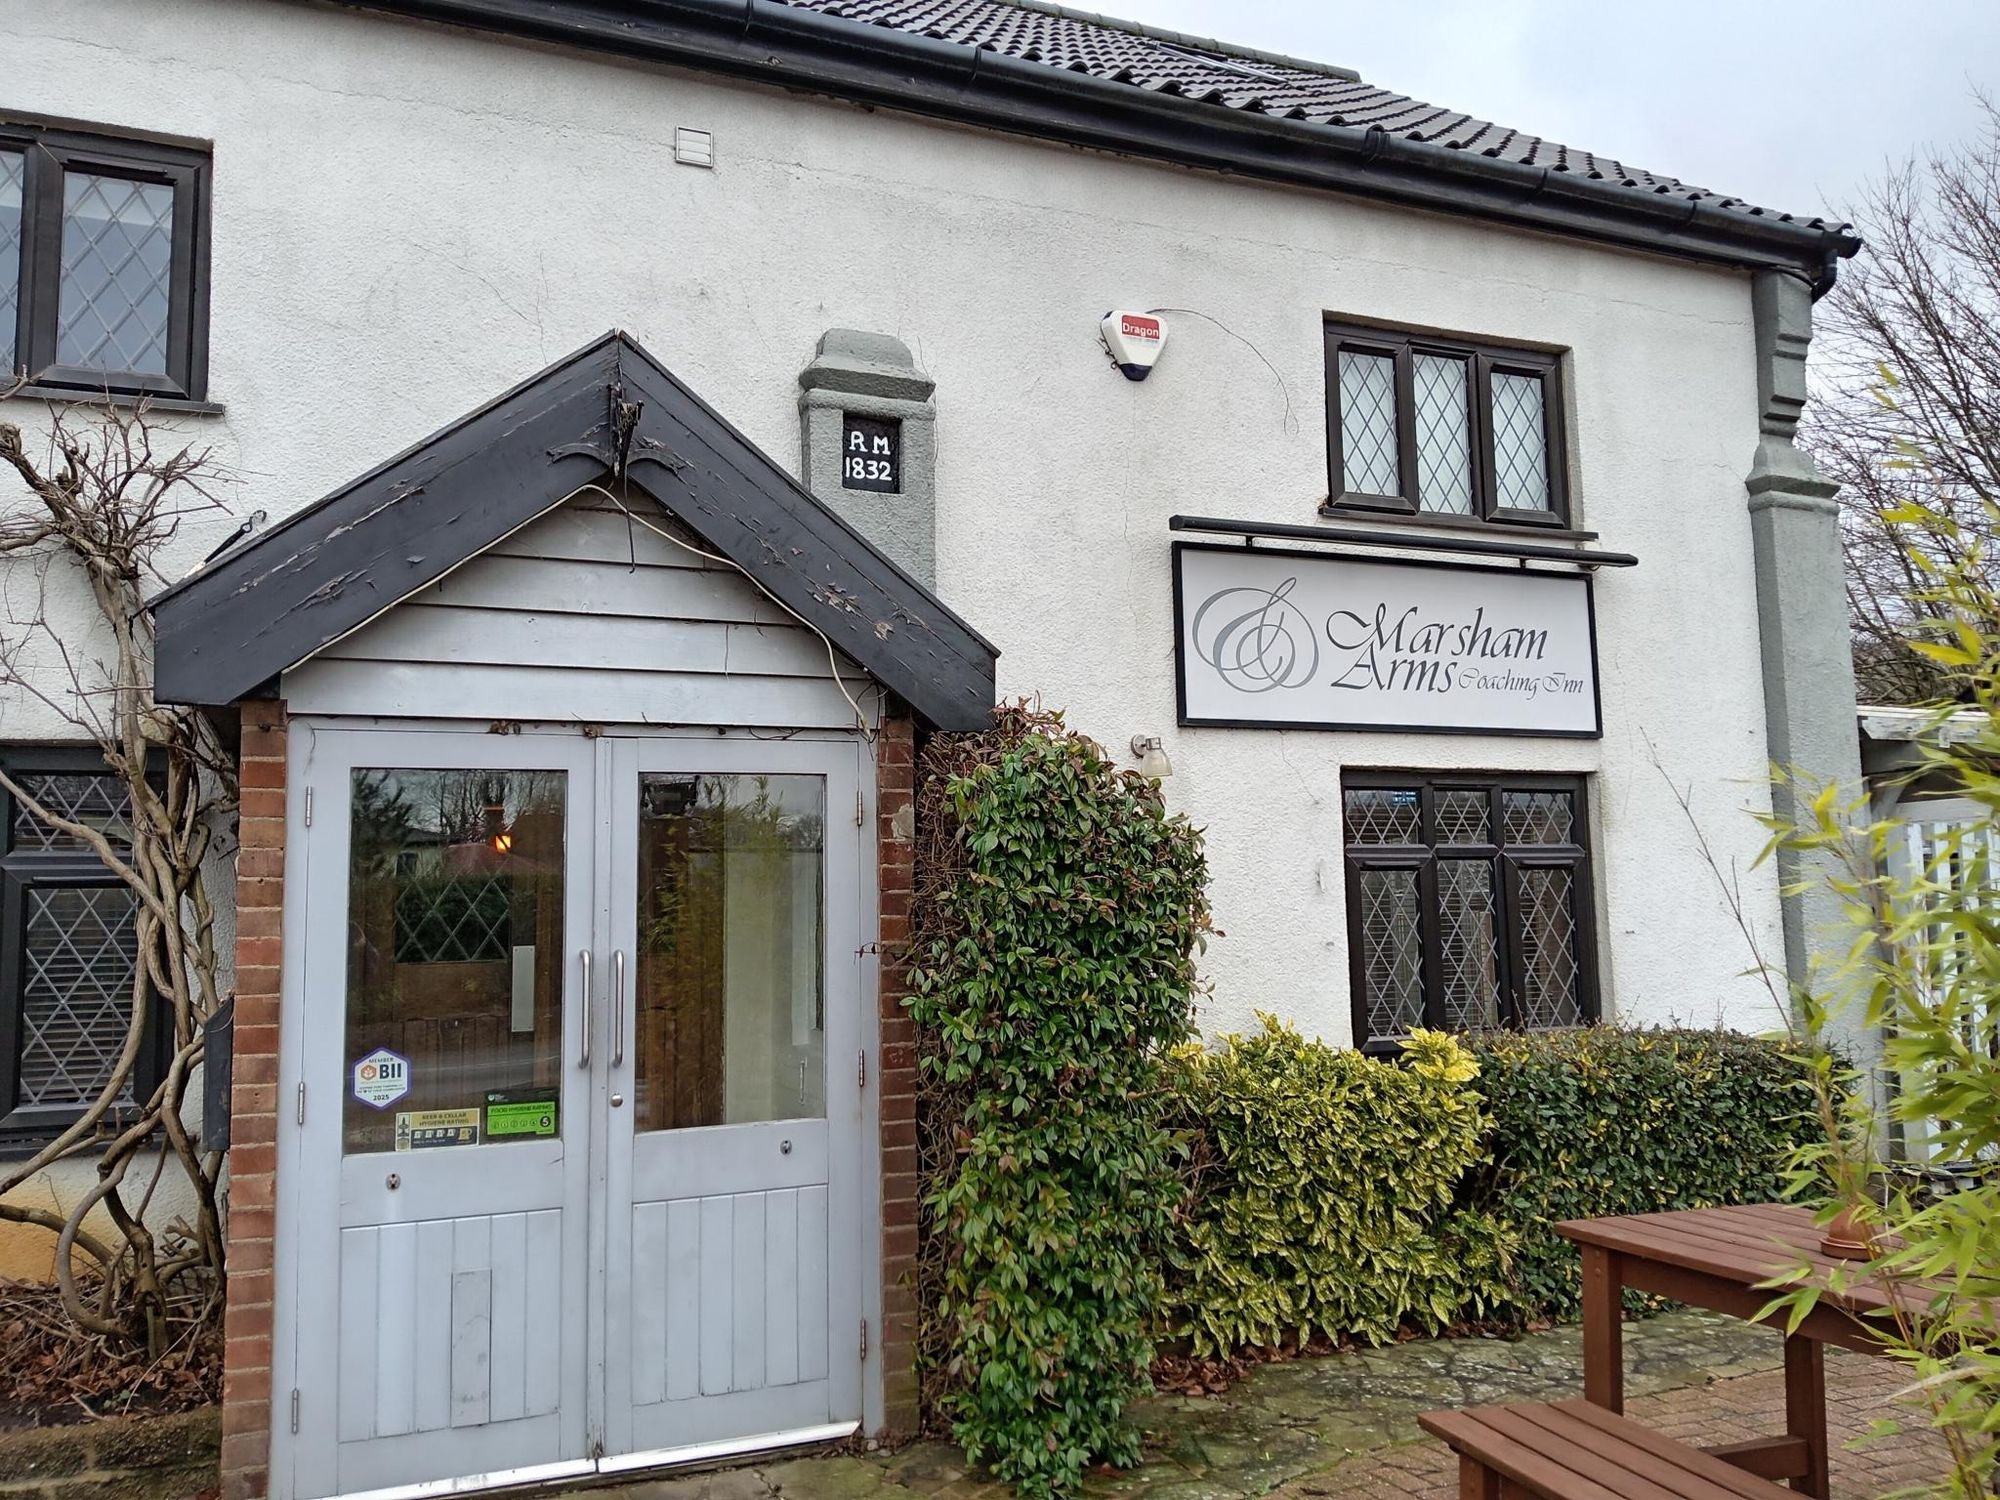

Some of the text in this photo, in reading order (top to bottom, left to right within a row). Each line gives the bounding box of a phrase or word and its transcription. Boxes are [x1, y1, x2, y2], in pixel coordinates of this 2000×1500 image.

[1122, 322, 1159, 337] Dragon
[849, 430, 891, 455] R M
[845, 456, 892, 481] 1832
[1326, 602, 1549, 661] Marsham
[1331, 640, 1584, 700] Arms Coaching Inn
